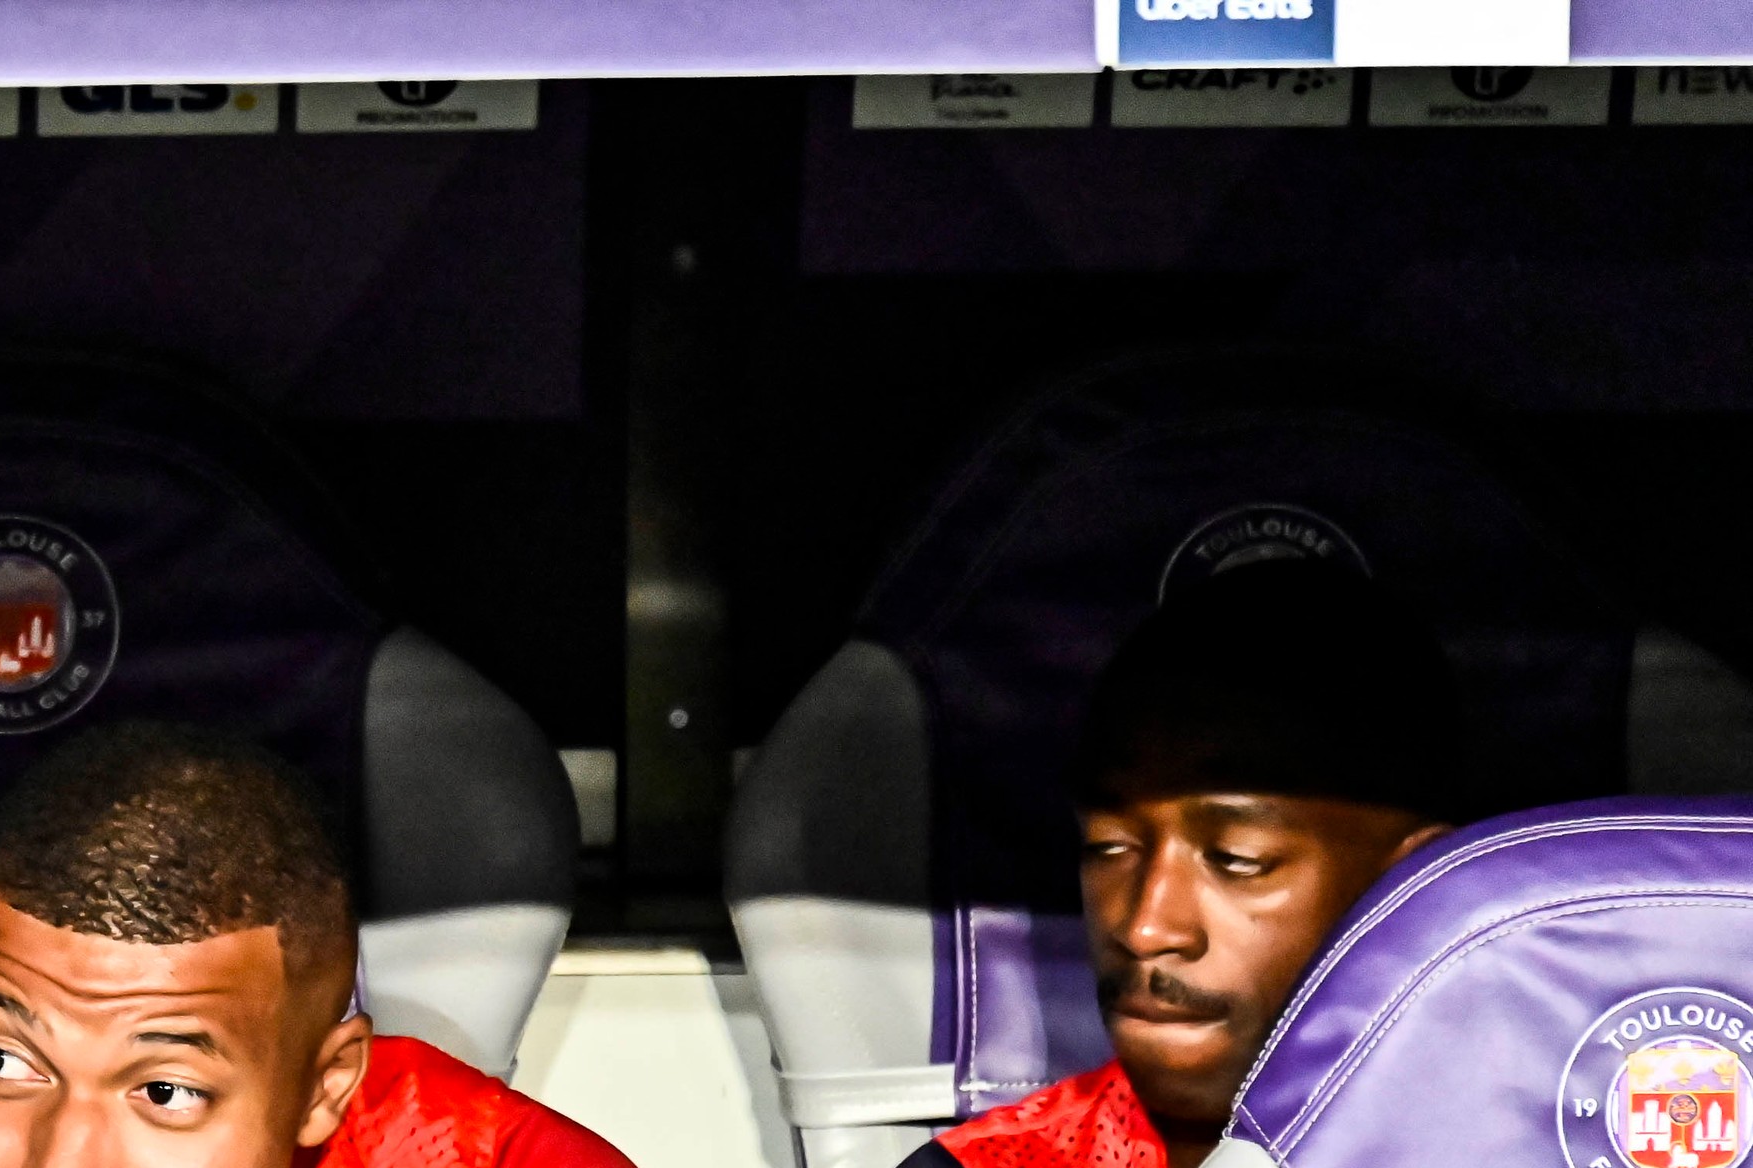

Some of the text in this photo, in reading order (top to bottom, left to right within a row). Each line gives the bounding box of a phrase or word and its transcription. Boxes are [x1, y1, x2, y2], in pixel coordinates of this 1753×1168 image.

[38, 664, 90, 710] CLUB
[1600, 1004, 1753, 1053] TOULOUSE
[1573, 1098, 1597, 1118] 19
